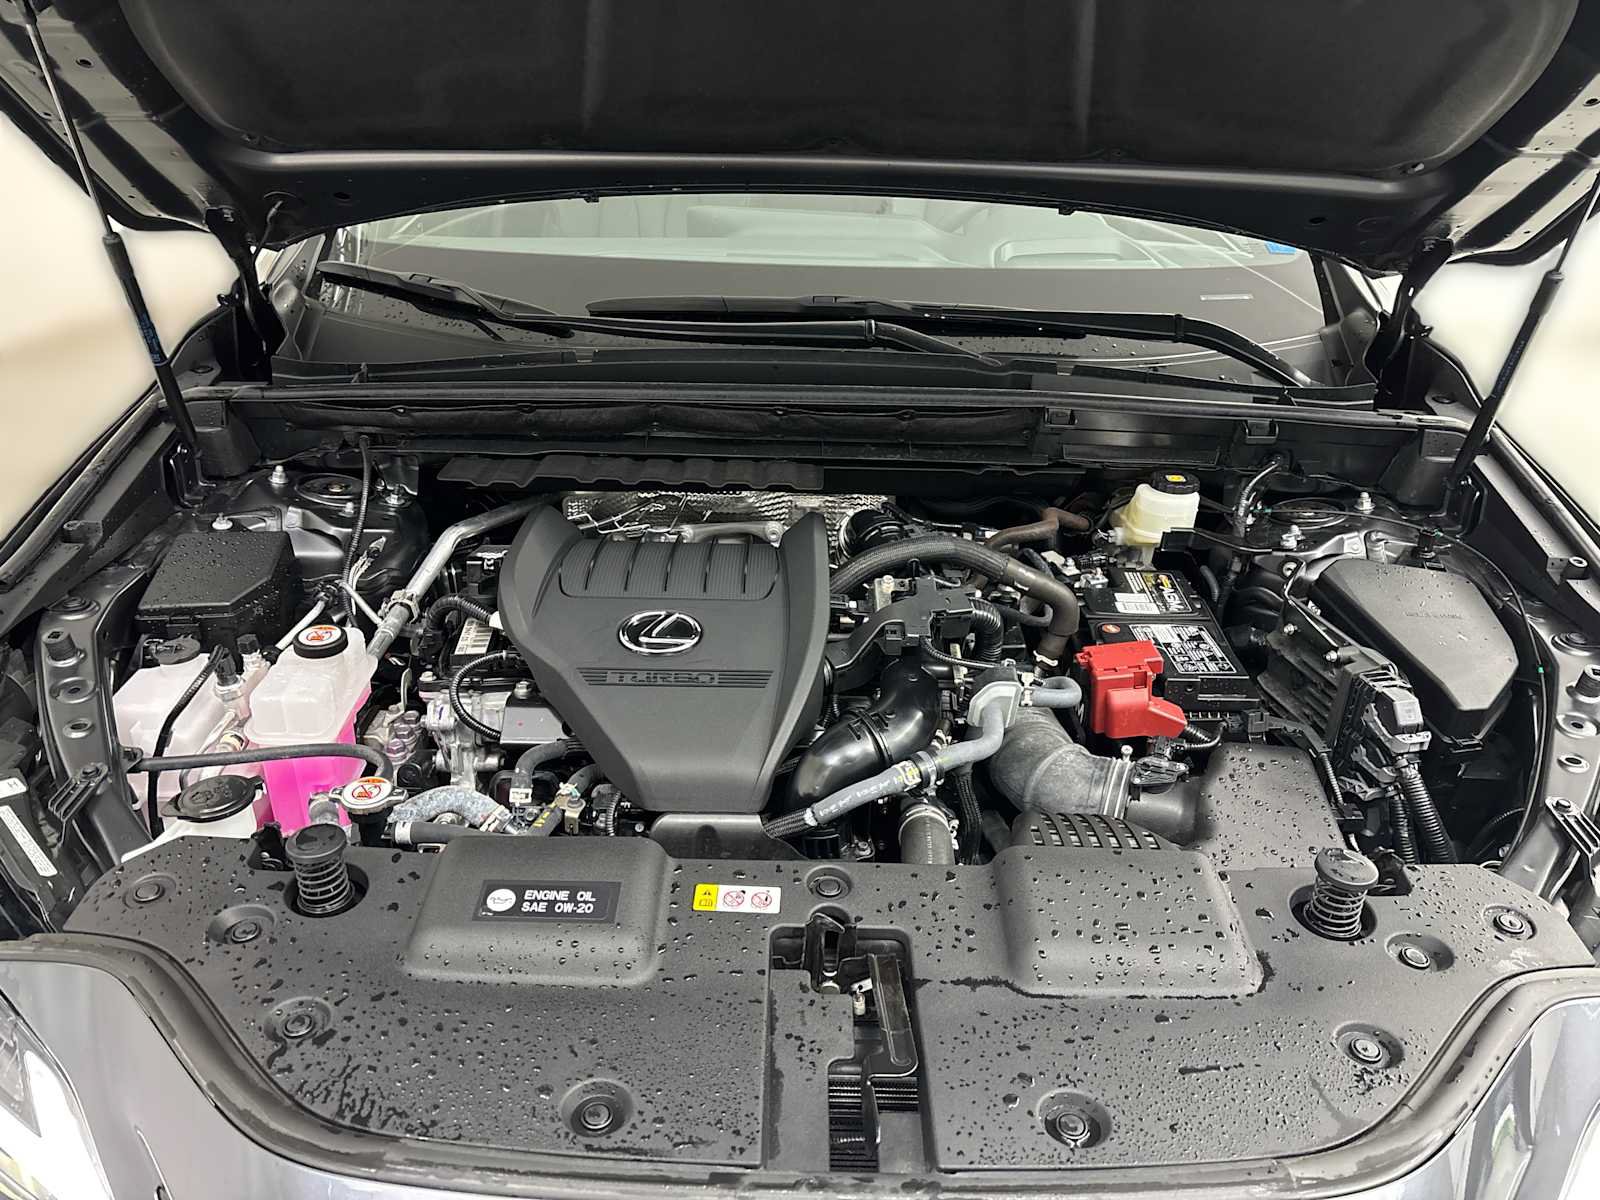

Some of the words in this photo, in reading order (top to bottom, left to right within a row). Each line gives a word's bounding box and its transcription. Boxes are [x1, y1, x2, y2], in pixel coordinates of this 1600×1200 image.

[610, 671, 717, 684] TURBO
[523, 889, 570, 901] ENGINE
[576, 891, 596, 902] OIL
[520, 902, 548, 913] SAE
